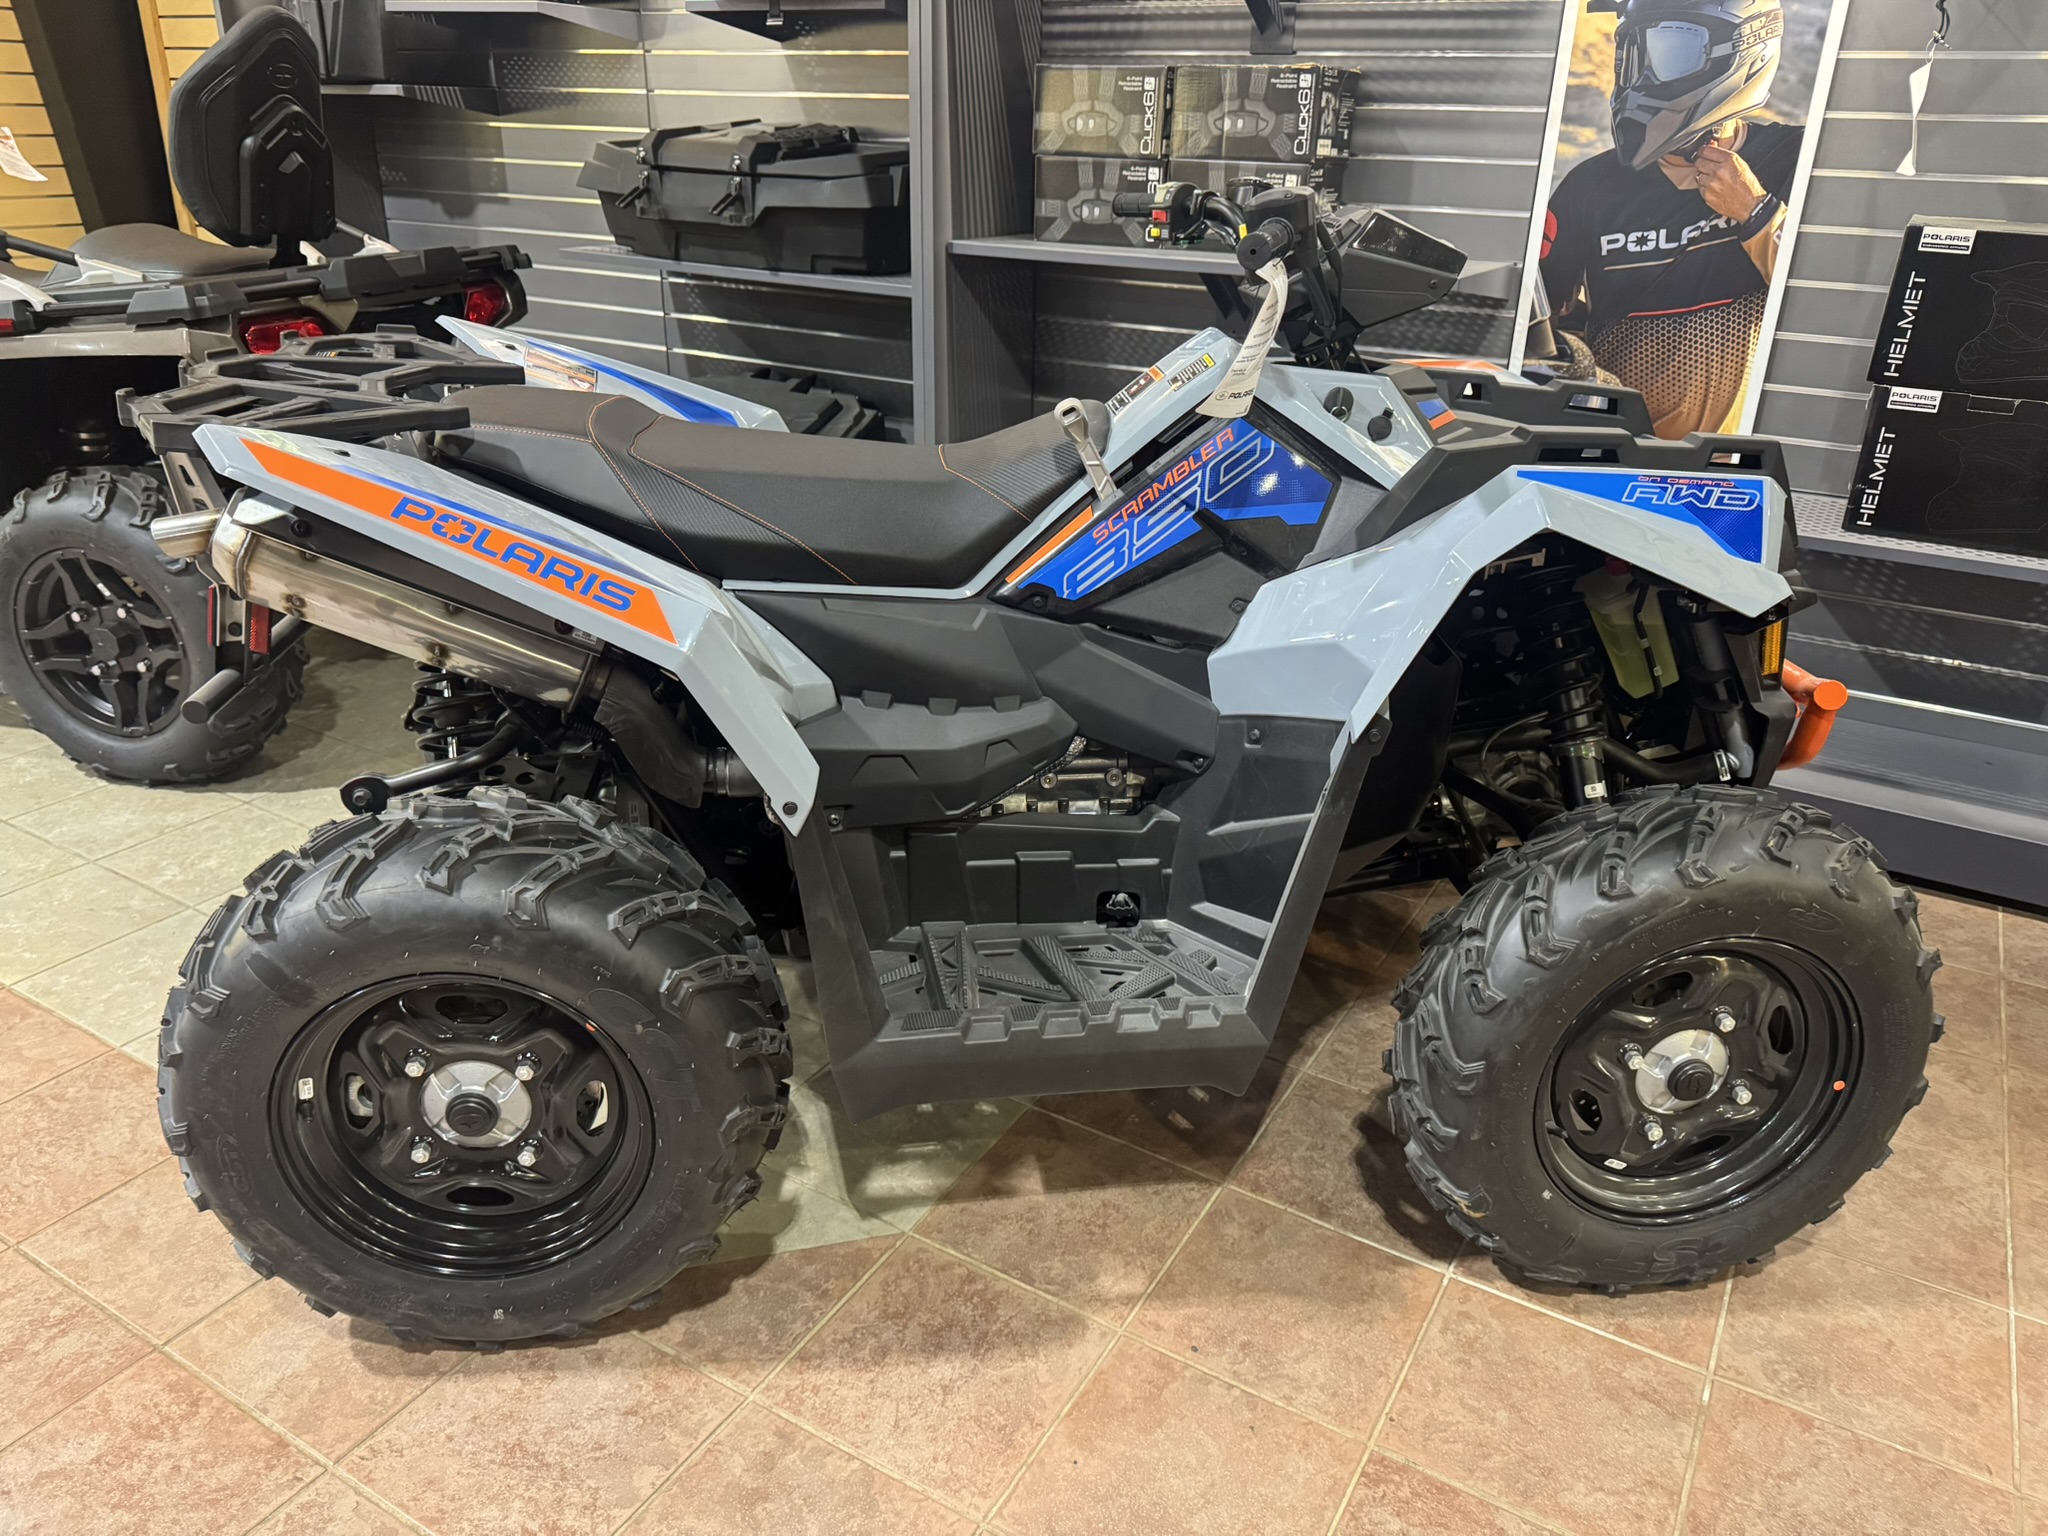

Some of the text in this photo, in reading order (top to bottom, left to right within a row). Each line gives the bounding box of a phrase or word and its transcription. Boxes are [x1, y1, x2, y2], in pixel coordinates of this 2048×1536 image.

[1600, 215, 1738, 256] POLAR
[1923, 233, 1971, 242] POLARIS
[1884, 271, 1927, 377] HELMET
[1891, 392, 1937, 401] POLARIS
[1092, 427, 1235, 545] SCRAMBLER
[1621, 482, 1761, 511] AWD
[1638, 475, 1735, 487] ON DEMAND
[1856, 427, 1896, 527] HELMET
[389, 496, 638, 613] POLARIS
